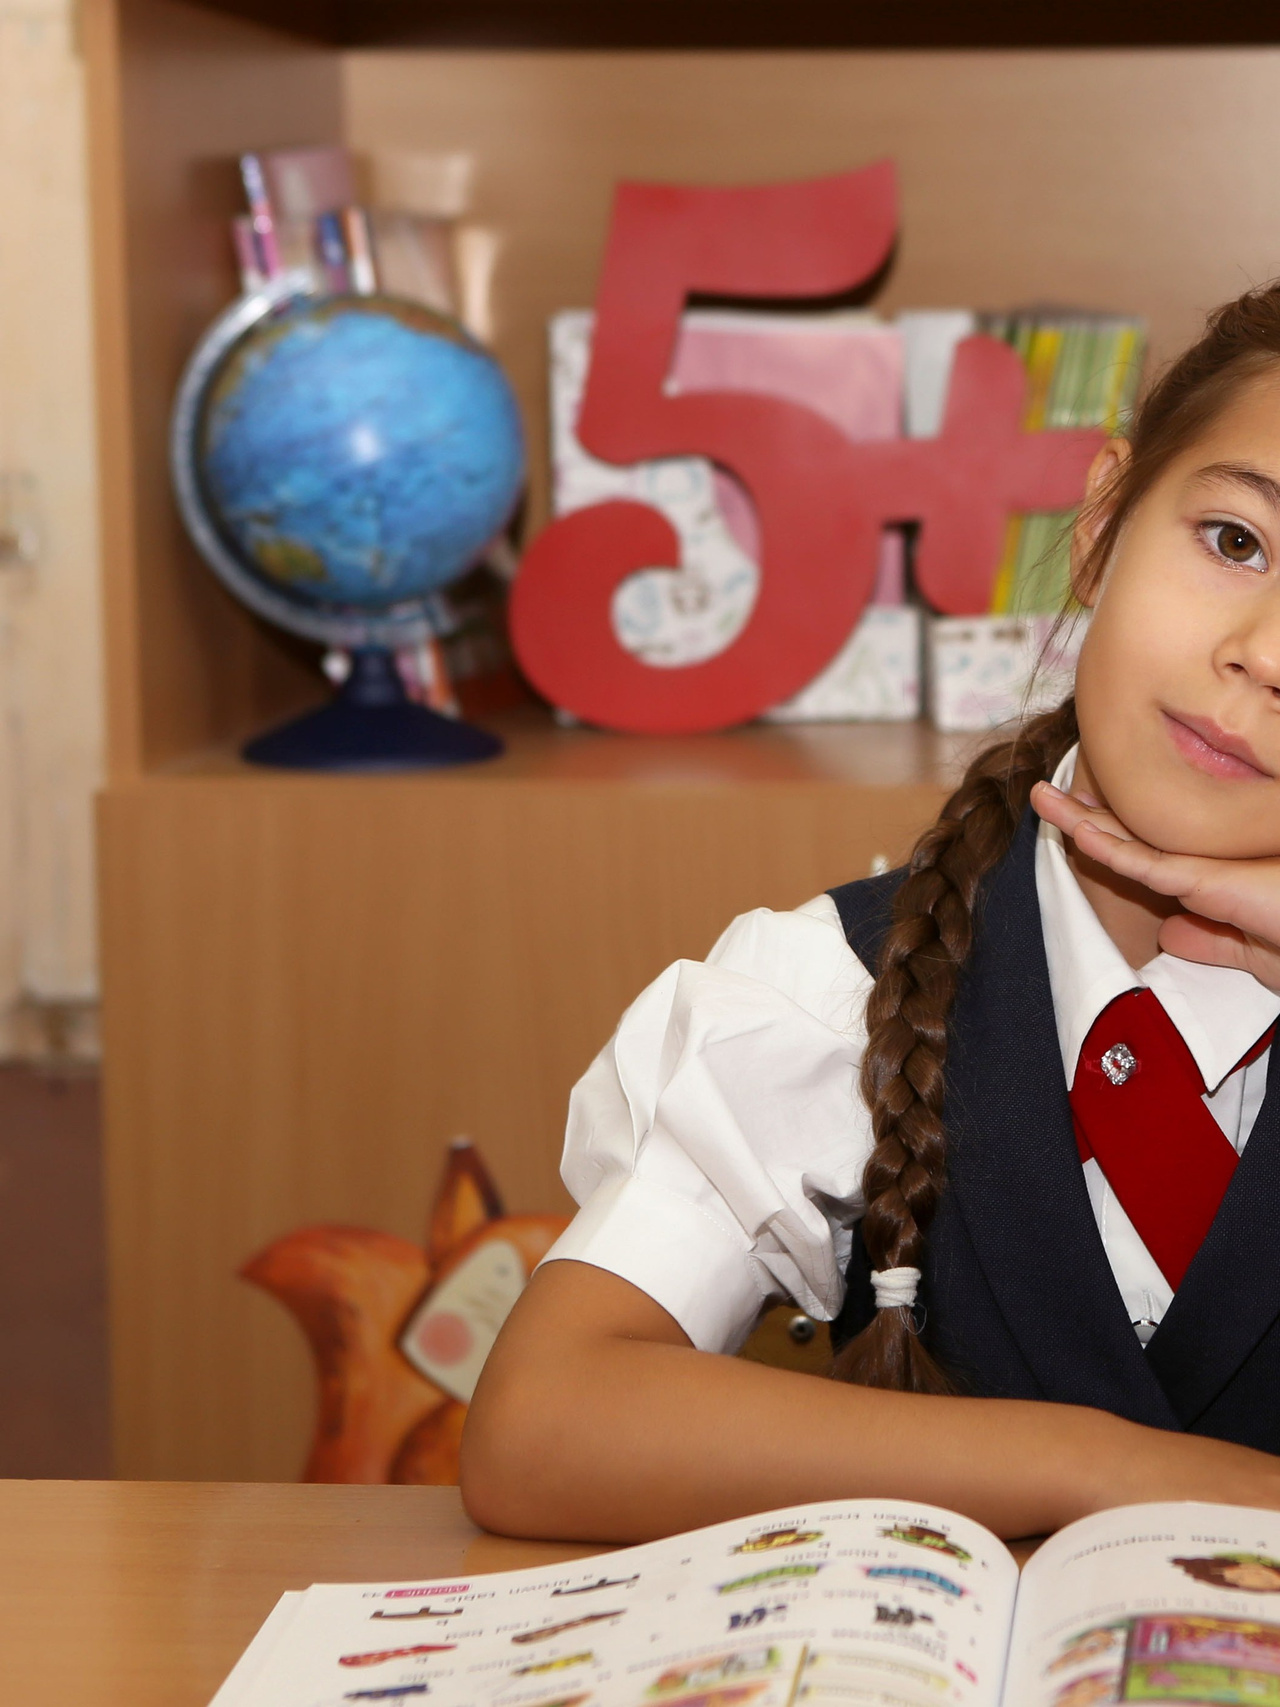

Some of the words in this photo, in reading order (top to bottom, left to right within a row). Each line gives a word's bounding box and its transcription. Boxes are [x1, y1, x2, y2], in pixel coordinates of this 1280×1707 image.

[818, 1512, 861, 1523] tree
[872, 1512, 930, 1526] green
[747, 1518, 808, 1536] house
[508, 1579, 571, 1595] brown
[443, 1591, 496, 1604] table
[443, 1627, 484, 1642] bed
